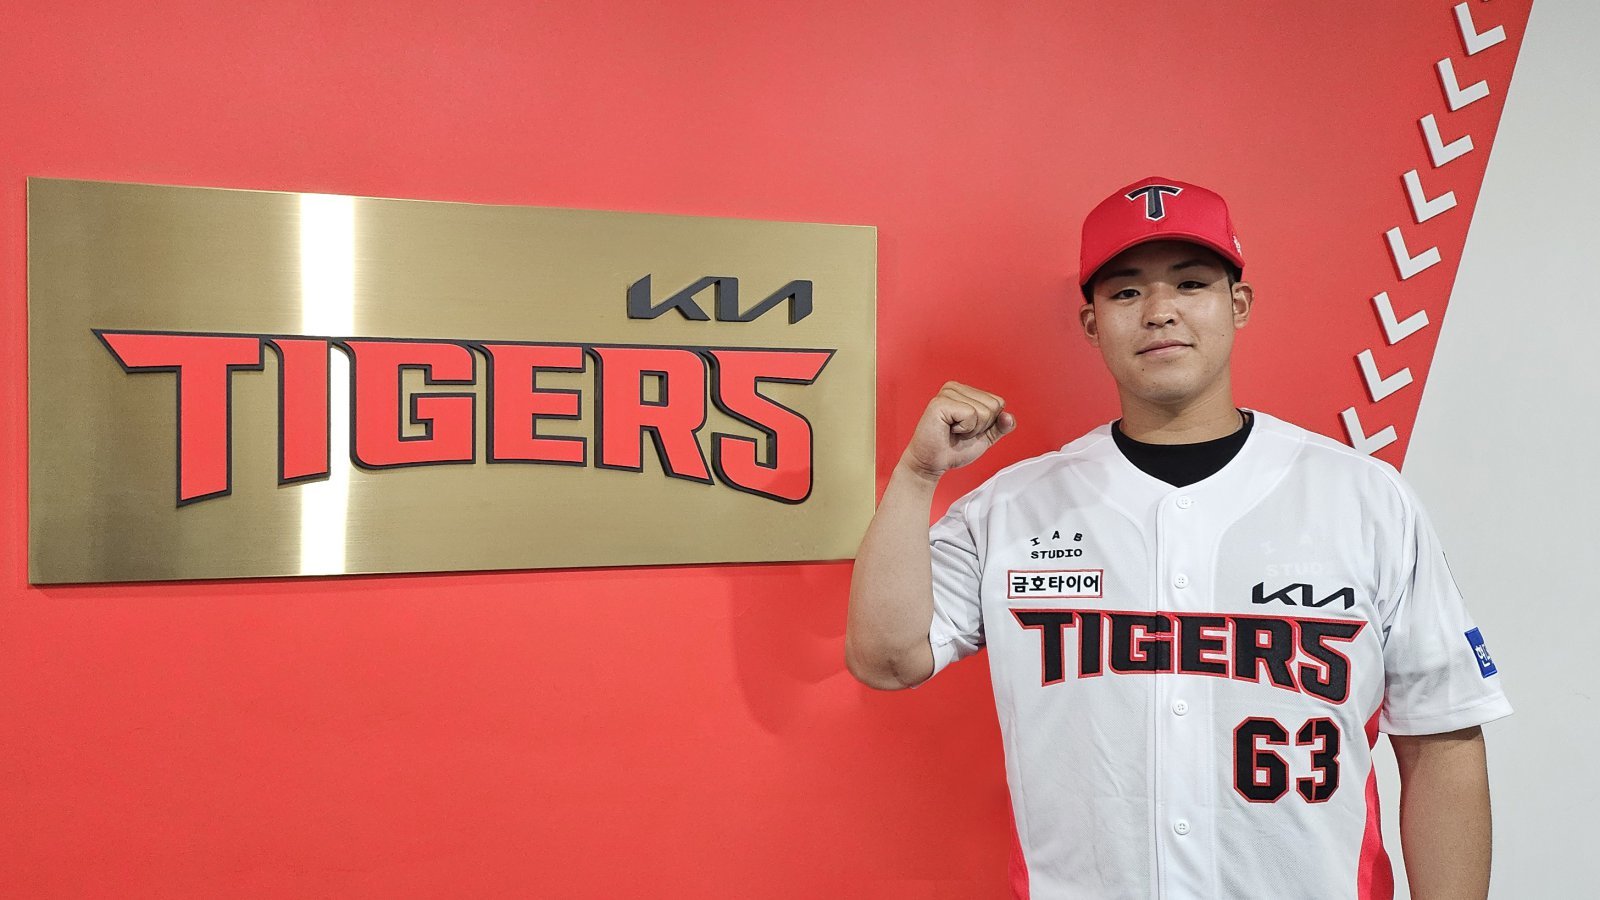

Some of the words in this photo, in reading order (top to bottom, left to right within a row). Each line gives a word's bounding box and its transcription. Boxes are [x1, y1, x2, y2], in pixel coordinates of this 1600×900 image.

[1124, 184, 1184, 221] T
[627, 274, 813, 324] KIA
[92, 328, 837, 507] TIGERS
[1030, 548, 1083, 560] STUDIO
[1011, 574, 1099, 594] 금호타이어
[1252, 582, 1355, 611] KIA
[1008, 608, 1369, 706] TIGERS
[1232, 716, 1341, 804] 63
